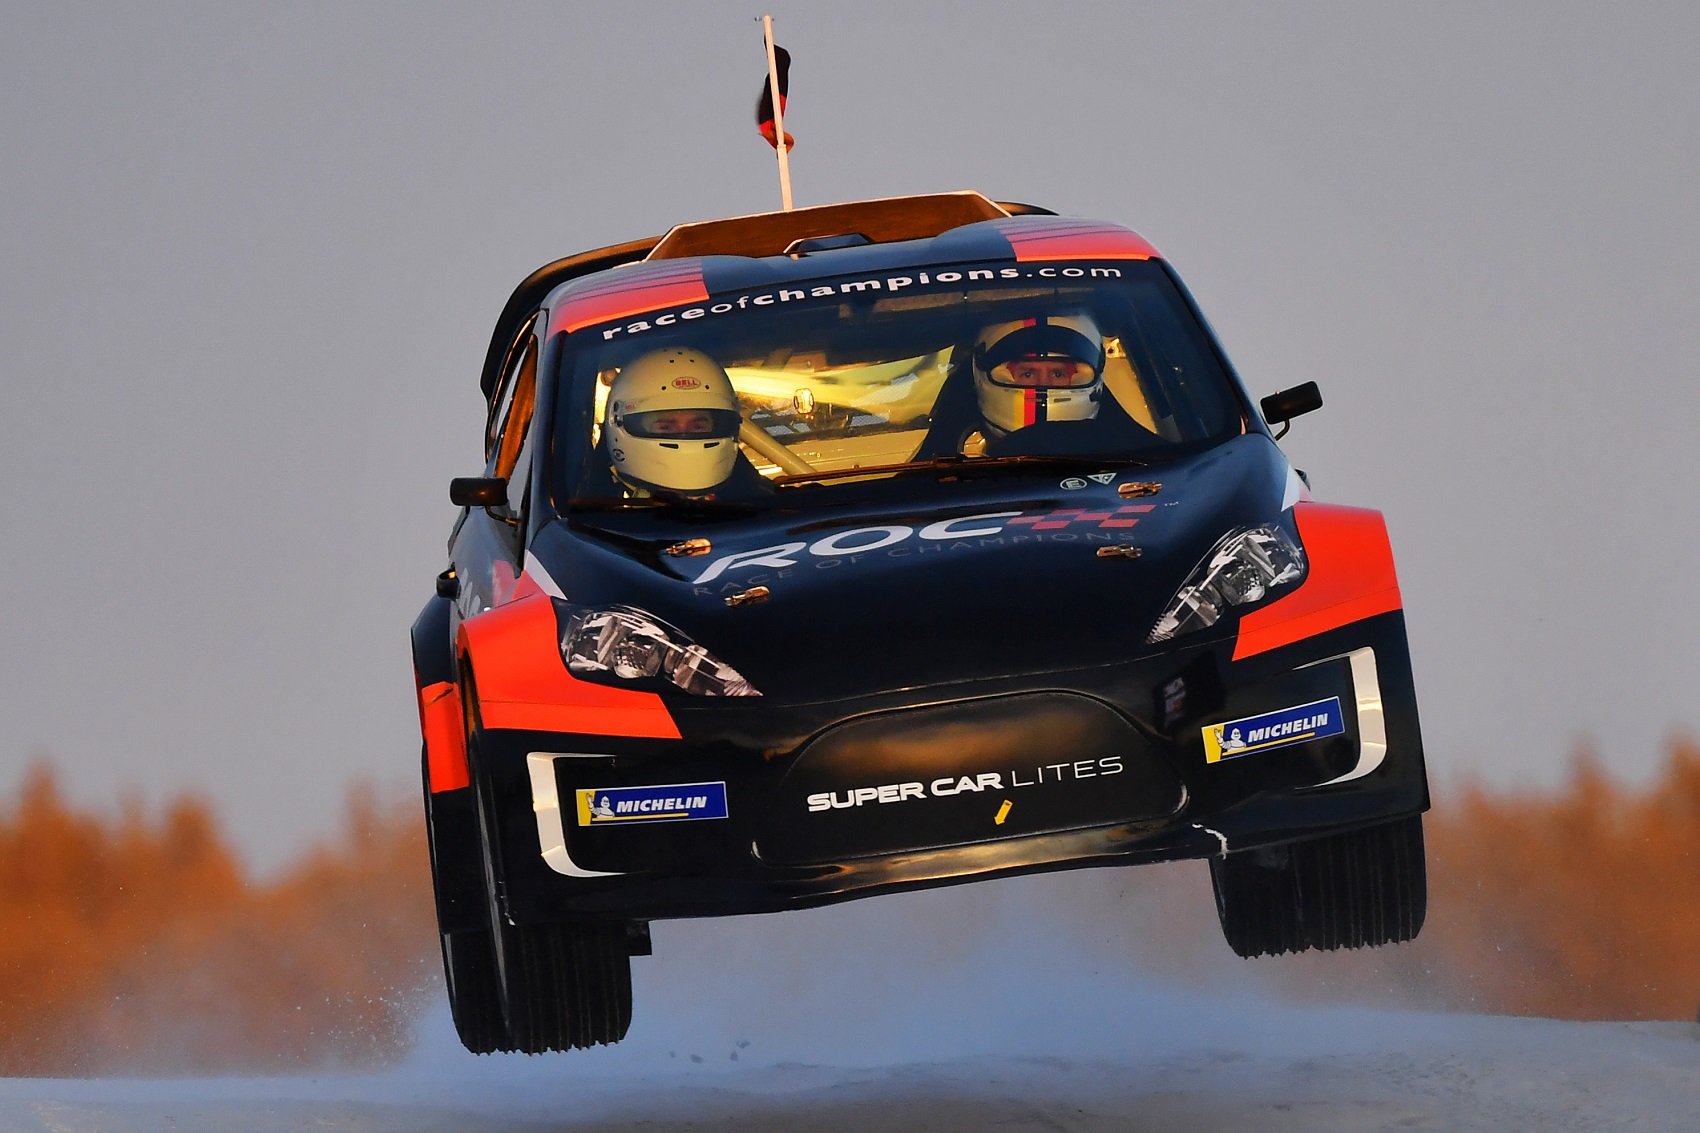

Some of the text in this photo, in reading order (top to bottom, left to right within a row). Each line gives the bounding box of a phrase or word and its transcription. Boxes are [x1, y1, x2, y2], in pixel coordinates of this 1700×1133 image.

[602, 265, 1122, 341] raceofchampions.com
[692, 511, 1023, 584] ROC
[693, 532, 1135, 596] RACE OF CHAMPIONS
[1247, 713, 1328, 743] MICHELIN
[616, 796, 707, 813] MICHELIN
[807, 756, 1123, 812] SUPER CAR LITES
